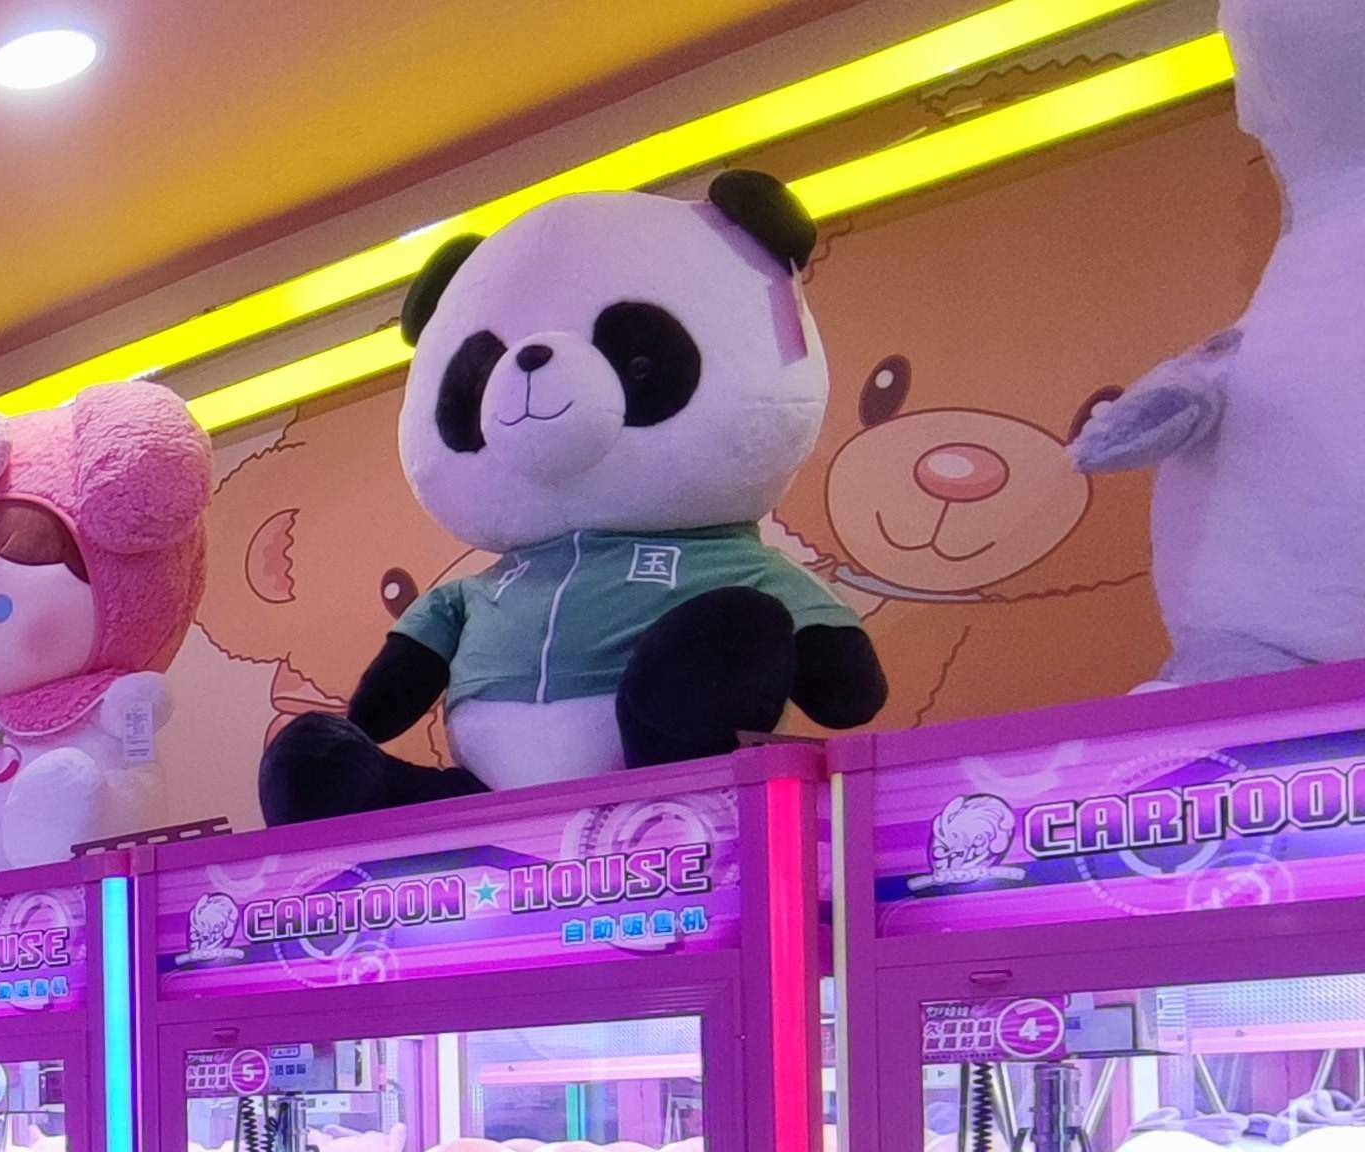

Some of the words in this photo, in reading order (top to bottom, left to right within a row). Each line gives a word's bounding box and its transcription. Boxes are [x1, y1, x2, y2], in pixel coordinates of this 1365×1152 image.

[626, 542, 682, 590] 国
[1023, 762, 1365, 861] CARTOO
[243, 875, 467, 943] CARTOON
[509, 843, 712, 913] HOUSE
[561, 905, 709, 945] 自助贩售机
